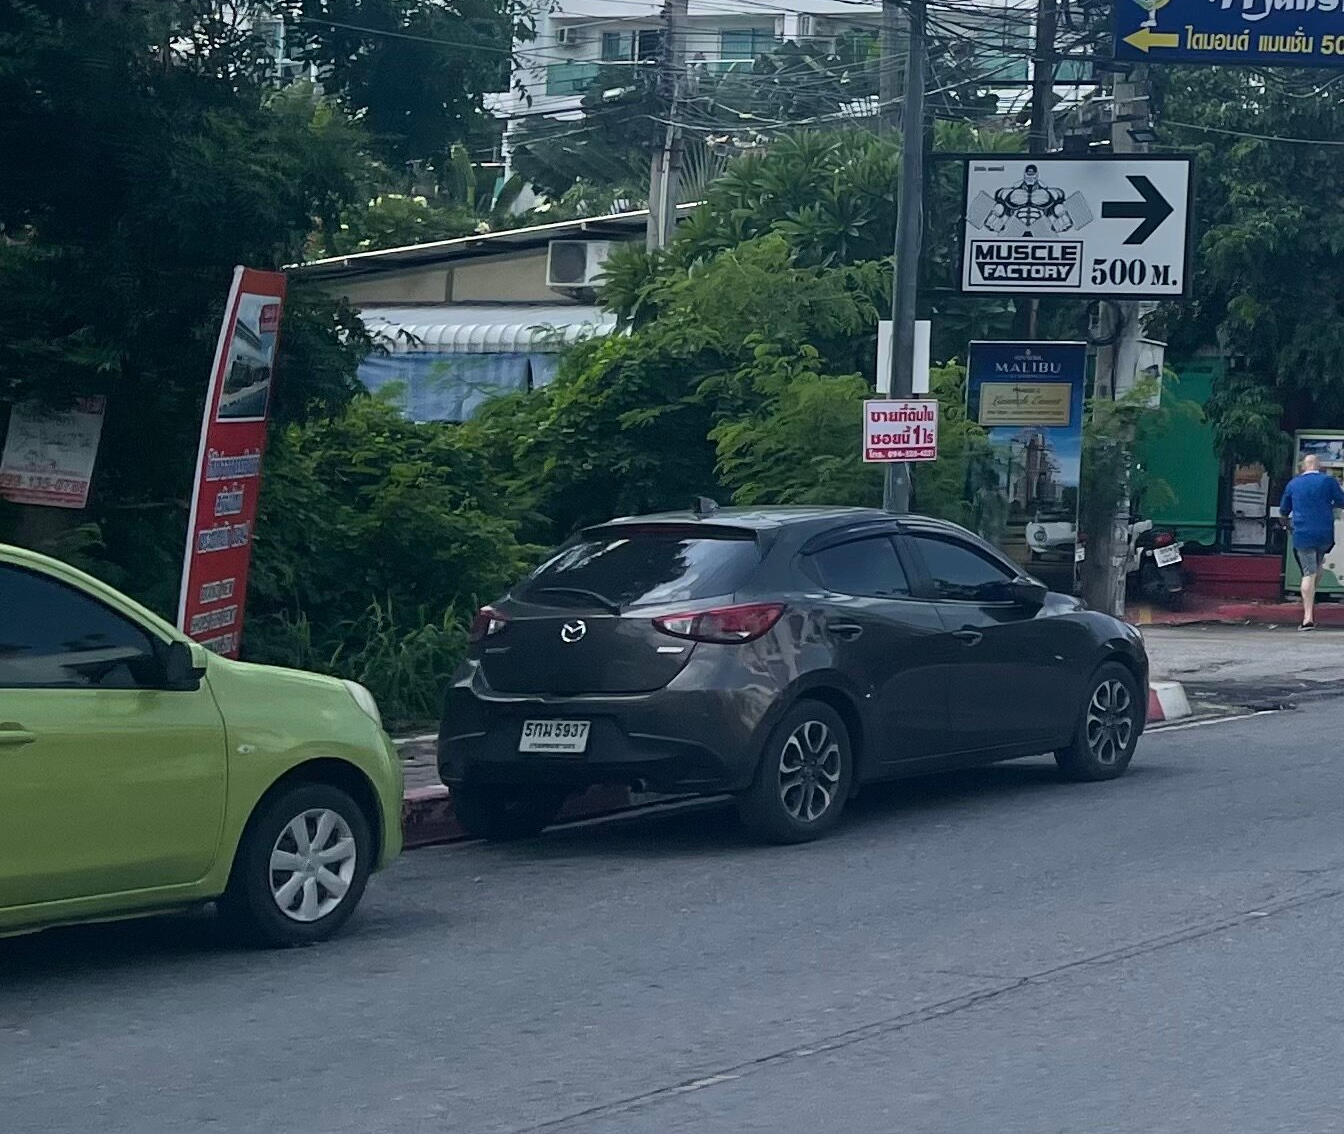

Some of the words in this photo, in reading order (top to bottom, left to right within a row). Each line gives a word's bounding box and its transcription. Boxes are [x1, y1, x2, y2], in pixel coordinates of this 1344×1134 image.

[1185, 25, 1250, 51] ไดมอนด์
[1258, 26, 1314, 53] แมนชั่น
[975, 244, 1077, 261] MUSCLE
[983, 264, 1070, 278] FACTORY
[1091, 258, 1146, 286] 500
[1151, 264, 1178, 286] M.
[995, 362, 1062, 373] MALIBU
[913, 425, 920, 444] 1
[555, 723, 588, 738] 5937
